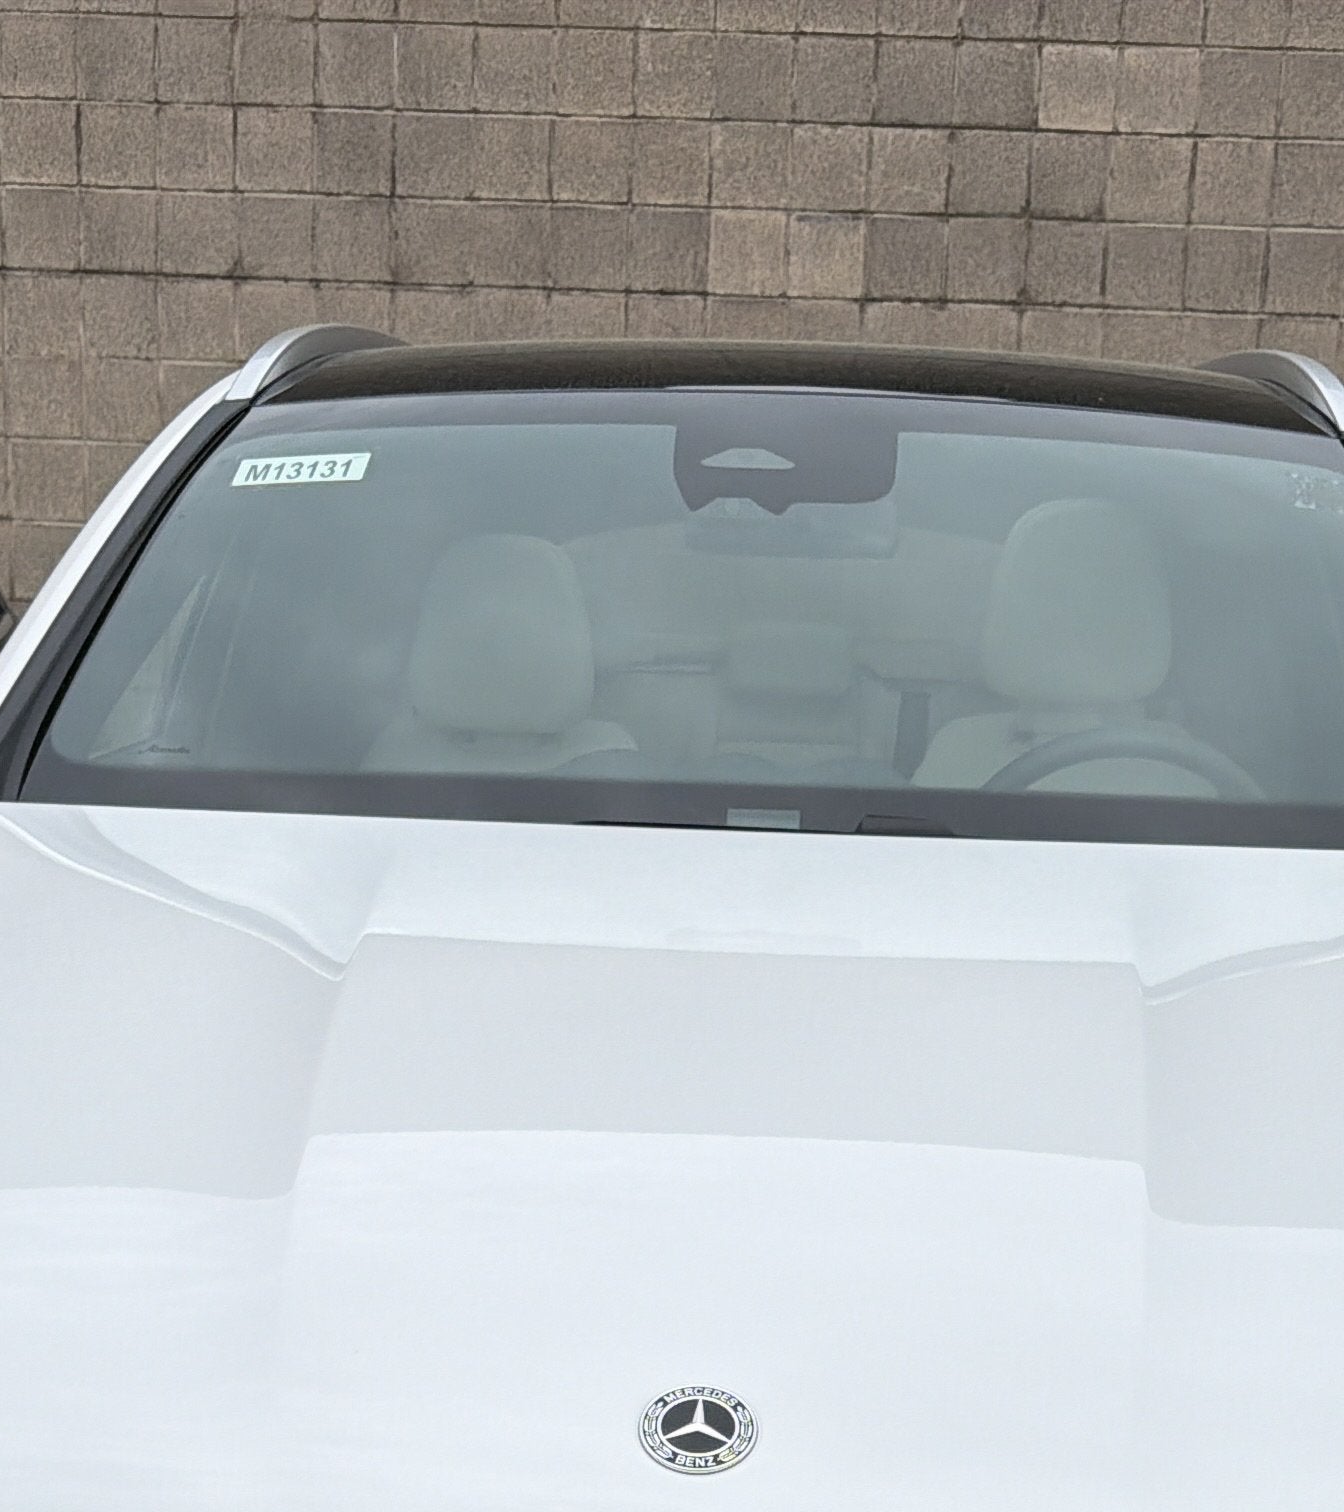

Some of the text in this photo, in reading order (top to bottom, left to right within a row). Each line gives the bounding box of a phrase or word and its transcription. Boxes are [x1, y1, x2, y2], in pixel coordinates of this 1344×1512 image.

[244, 459, 353, 481] M13131
[663, 1387, 738, 1407] MERCEDES
[675, 1456, 716, 1467] BENZ
